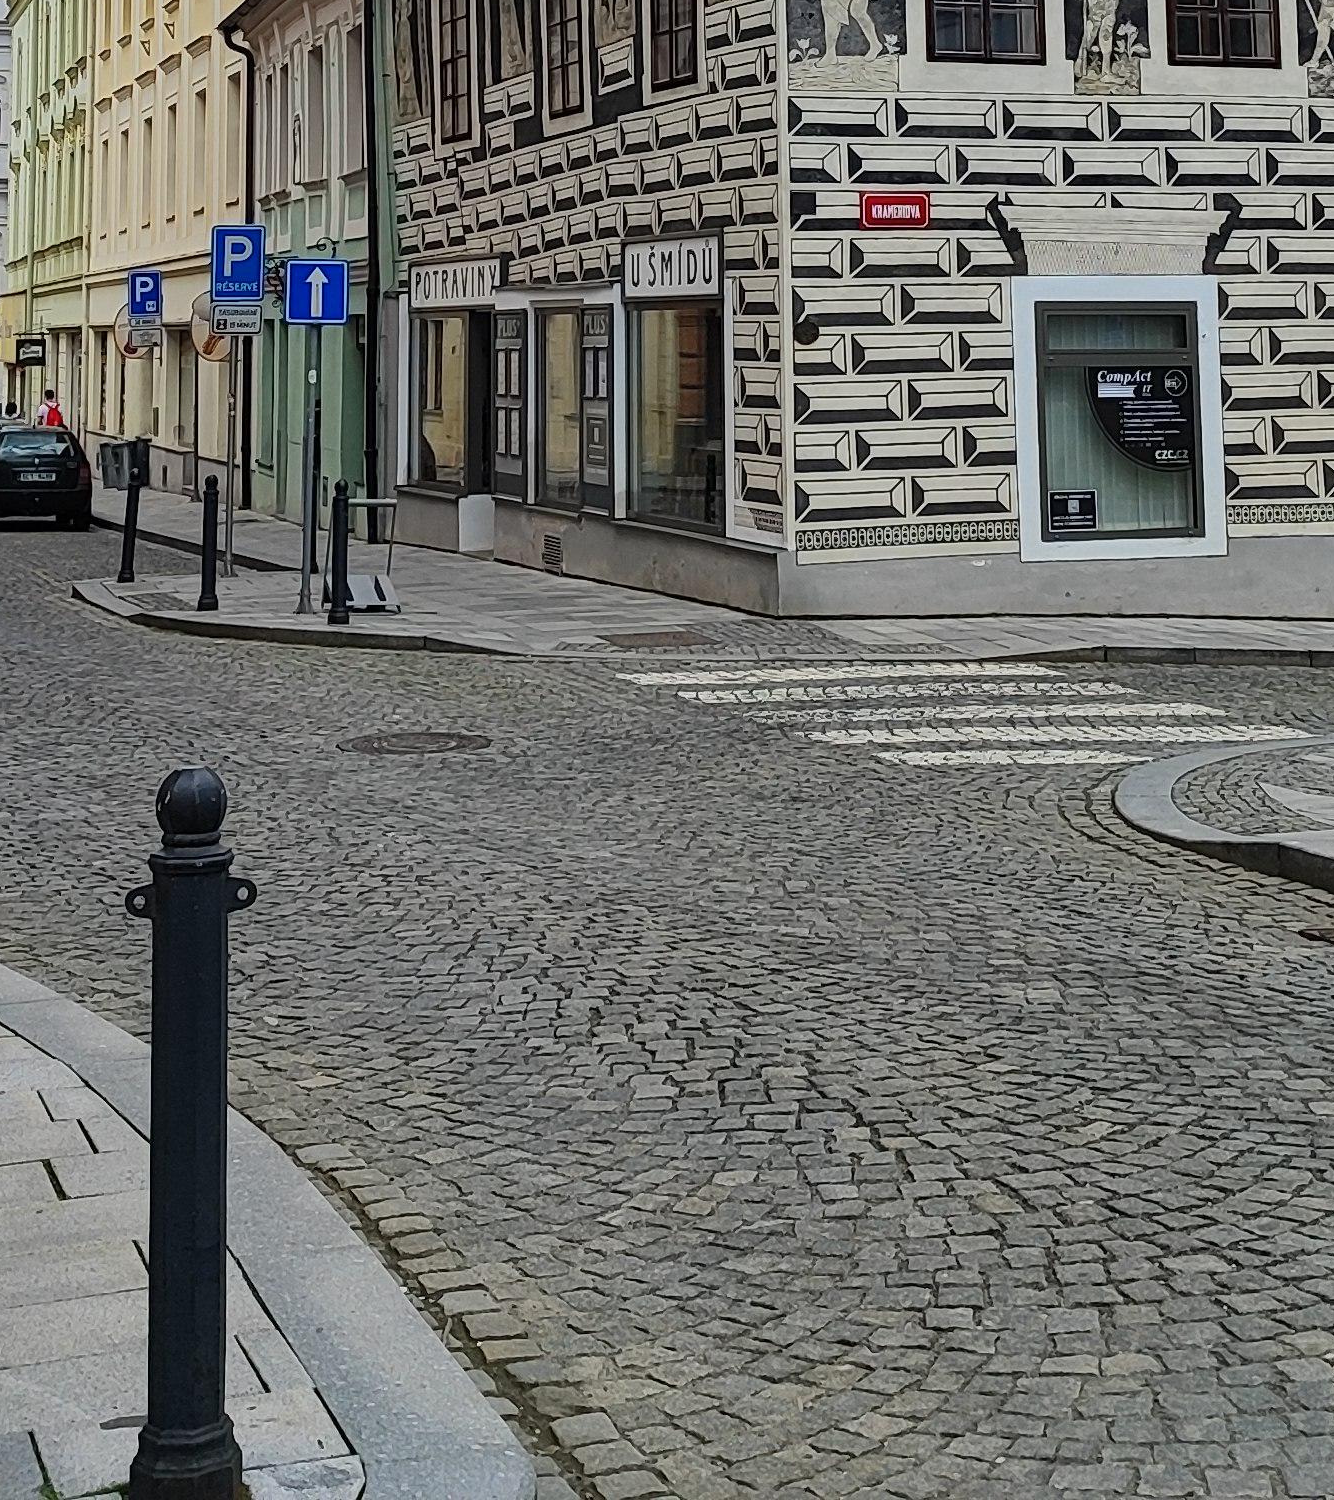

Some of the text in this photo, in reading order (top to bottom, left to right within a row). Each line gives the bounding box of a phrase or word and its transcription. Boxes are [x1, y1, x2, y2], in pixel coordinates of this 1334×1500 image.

[224, 236, 253, 276] P
[631, 239, 714, 288] U ŠMÍDŮ
[136, 277, 154, 302] P
[414, 264, 497, 301] POTRAVINY
[1097, 370, 1152, 385] CompAct
